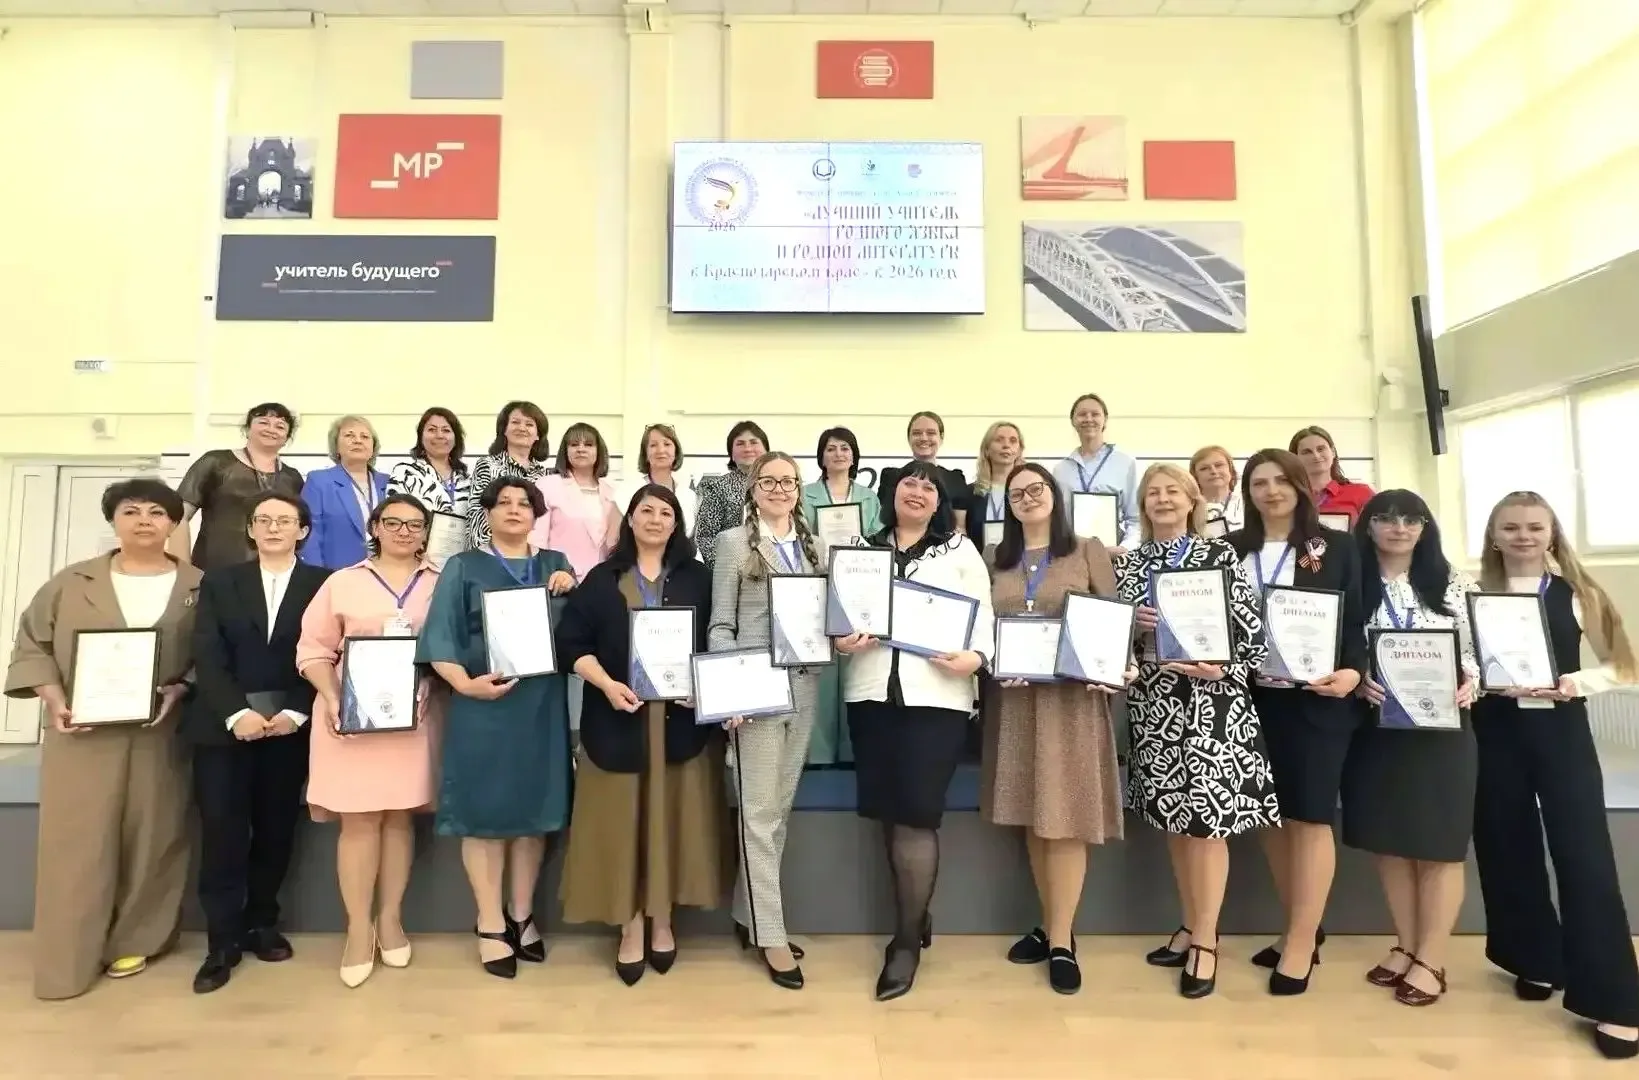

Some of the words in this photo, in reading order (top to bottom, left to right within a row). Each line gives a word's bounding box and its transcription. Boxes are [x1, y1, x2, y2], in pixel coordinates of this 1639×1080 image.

[275, 265, 348, 281] учитель
[351, 262, 440, 282] будущего
[889, 265, 924, 278] 2026
[1390, 651, 1442, 660] ДИПЛОМ
